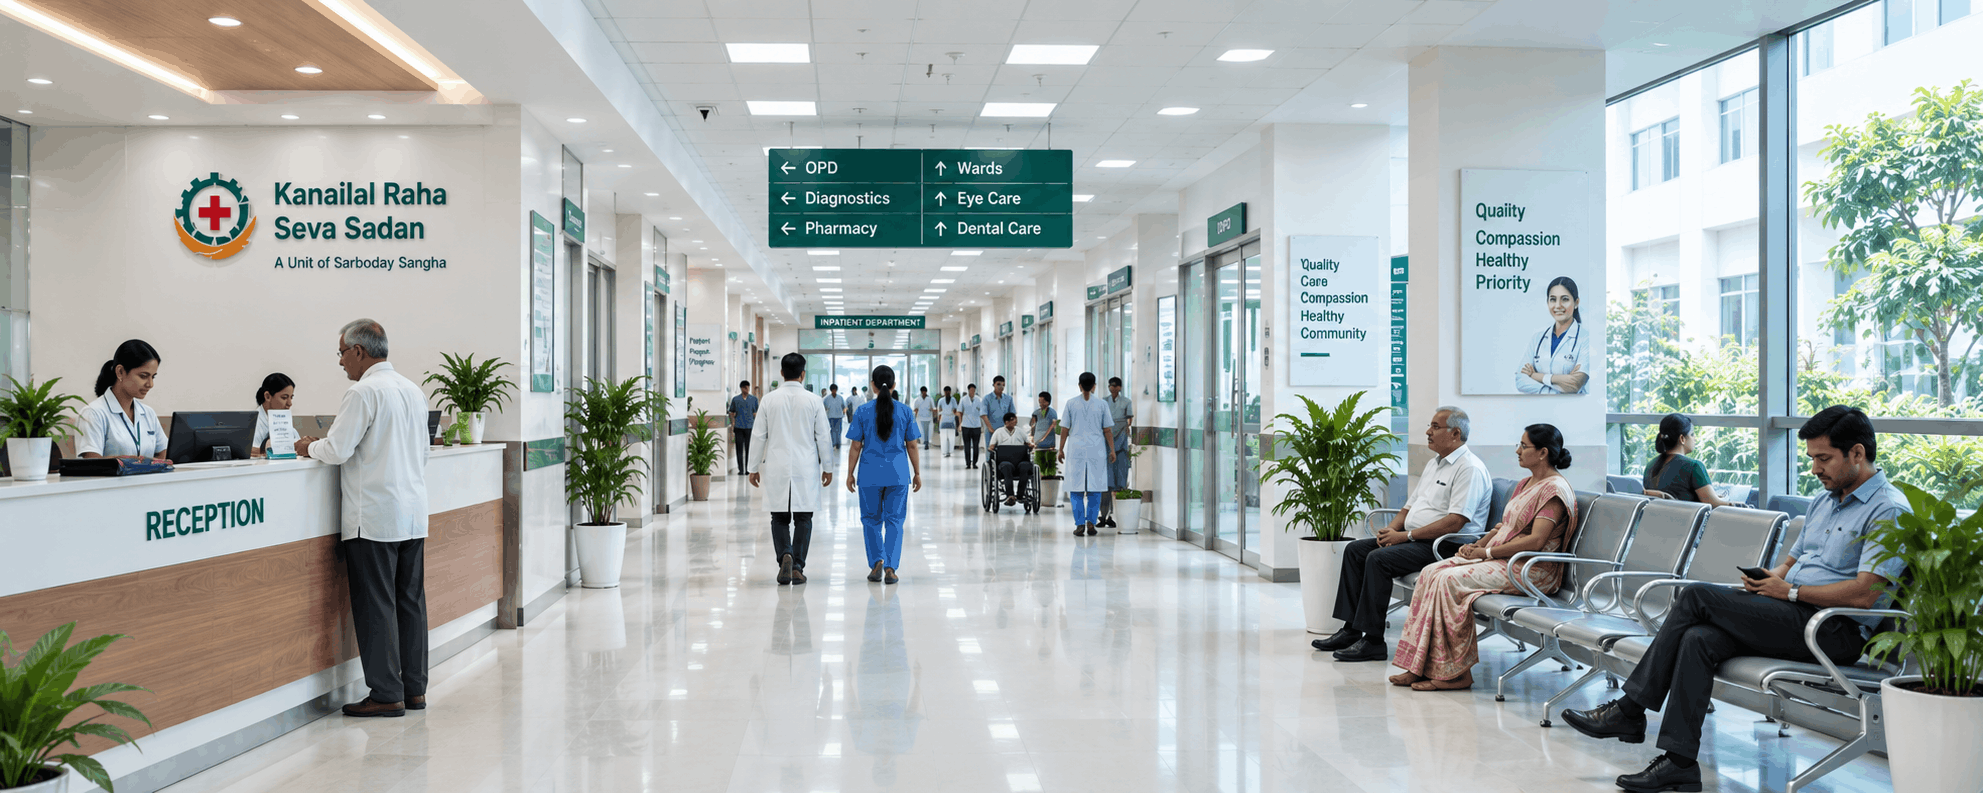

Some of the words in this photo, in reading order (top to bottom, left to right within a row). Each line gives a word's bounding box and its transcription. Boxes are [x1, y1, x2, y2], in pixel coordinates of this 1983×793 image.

[806, 161, 837, 174] OPD
[958, 161, 1002, 174] Wards
[275, 182, 374, 205] Kanailal
[384, 182, 446, 205] Raha
[806, 191, 890, 207] Diagnostics
[958, 192, 983, 207] Eye
[988, 192, 1021, 204] Care
[275, 217, 336, 239] Seva
[345, 216, 424, 239] Sadan
[806, 221, 877, 237] Pharmacy
[958, 222, 1003, 234] Dental
[1009, 222, 1041, 234] Care
[1476, 230, 1559, 248] Compassion
[275, 257, 283, 268] A
[288, 257, 313, 268] Unit
[318, 257, 330, 268] of
[335, 257, 394, 271] Sarboday
[399, 257, 446, 271] Sangha
[1477, 253, 1528, 271] Healthy
[1301, 275, 1327, 286] Care
[1477, 275, 1530, 293] Priority
[1301, 292, 1368, 306] Compassion
[820, 318, 863, 326] INPATIENT
[865, 318, 921, 327] DEPARTMENT
[1301, 310, 1344, 324] Healthy
[1301, 327, 1366, 341] Community
[147, 498, 263, 541] RECEPTION
